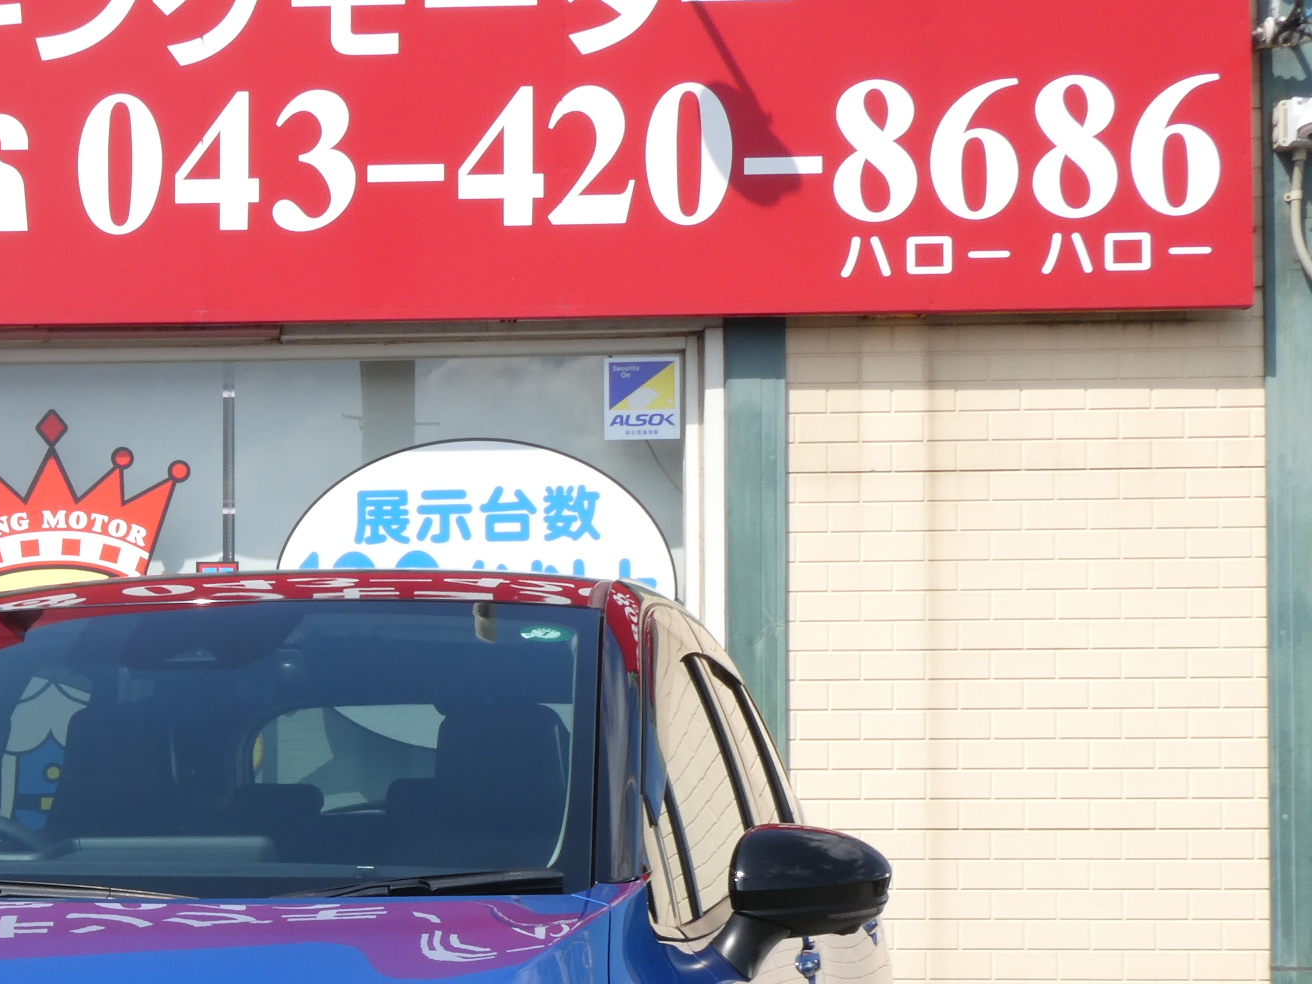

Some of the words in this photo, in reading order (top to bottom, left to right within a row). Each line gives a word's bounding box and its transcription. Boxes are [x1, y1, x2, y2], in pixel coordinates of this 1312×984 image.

[840, 236, 1011, 279] ハロー
[1041, 232, 1213, 275] ハロー
[609, 413, 675, 427] ALSOK
[42, 510, 148, 547] MOTOR
[353, 484, 602, 545] 展示台数
